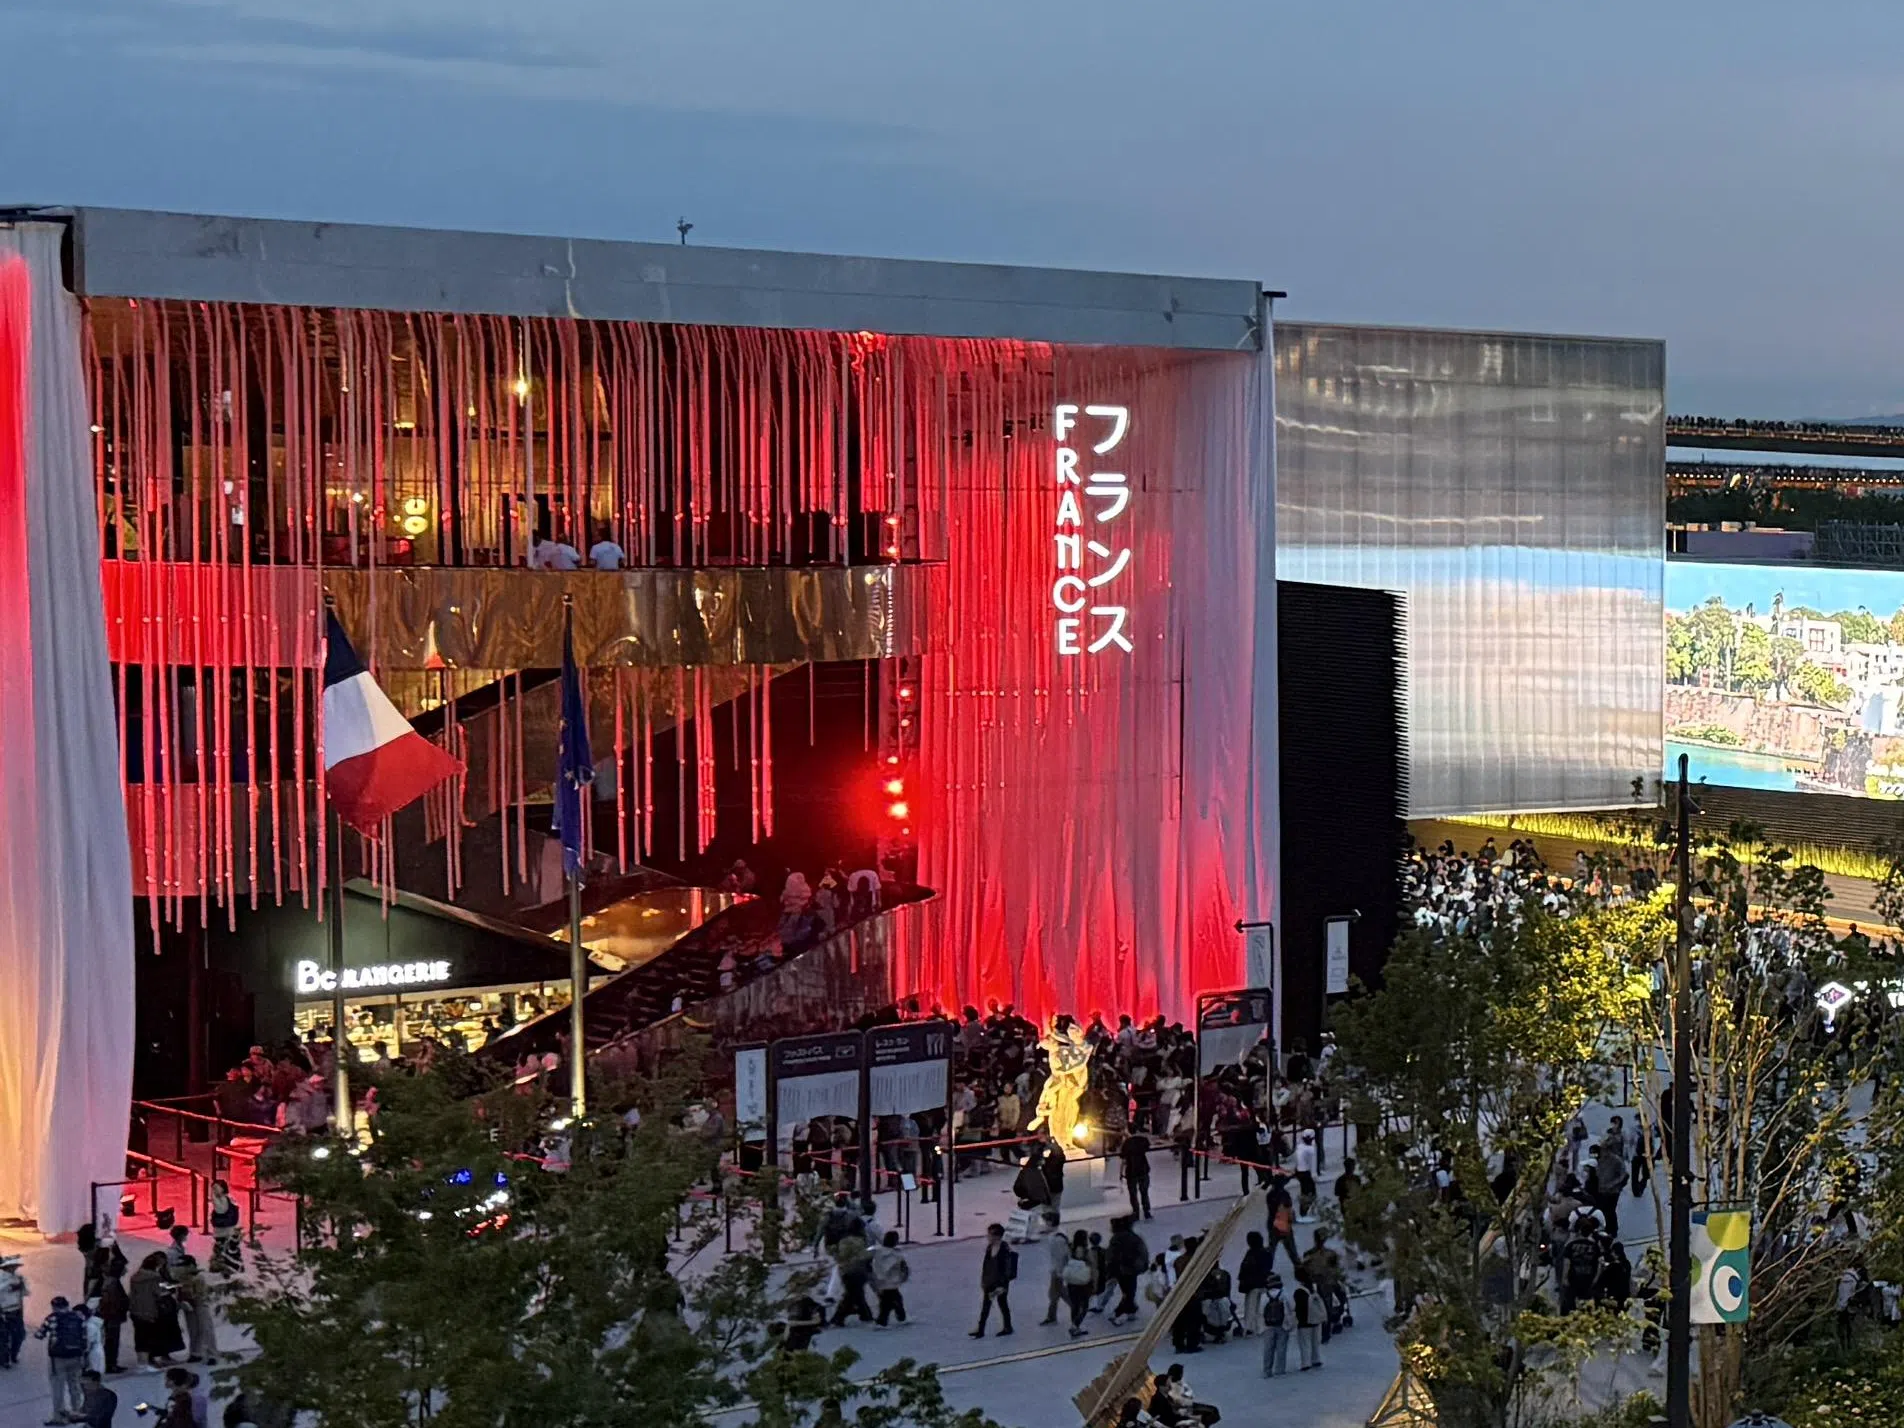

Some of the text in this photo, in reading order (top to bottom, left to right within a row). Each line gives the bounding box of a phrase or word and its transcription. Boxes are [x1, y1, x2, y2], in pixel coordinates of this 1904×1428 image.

[1053, 404, 1087, 655] FRANCE
[1085, 404, 1134, 654] フランス
